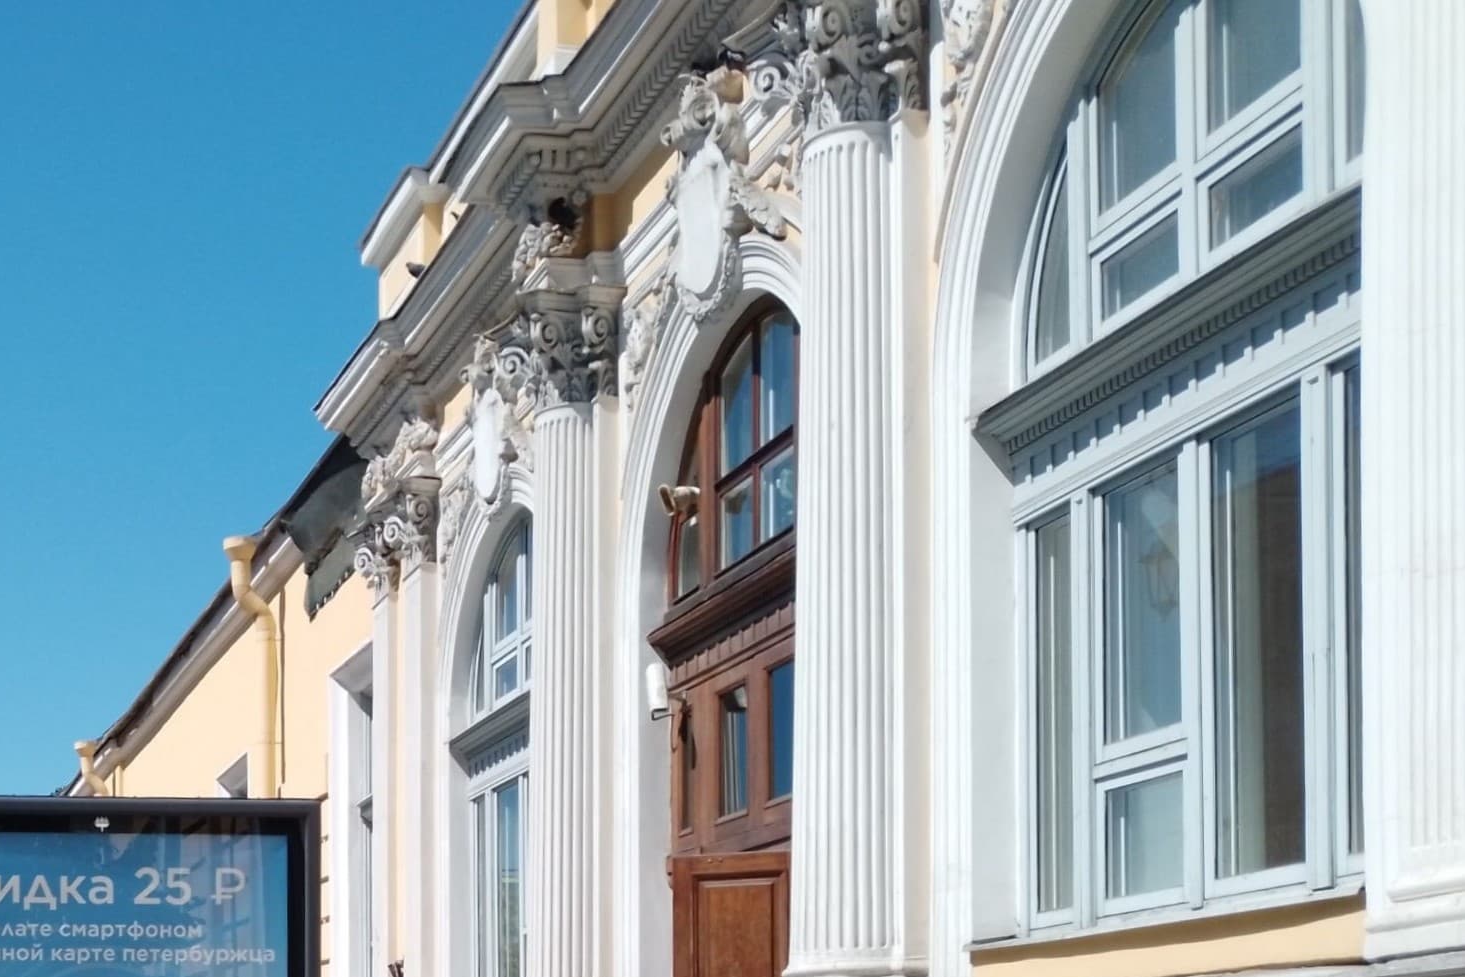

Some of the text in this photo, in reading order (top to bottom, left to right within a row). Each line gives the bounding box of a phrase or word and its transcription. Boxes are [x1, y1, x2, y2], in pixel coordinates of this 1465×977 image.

[134, 866, 192, 906] 25
[58, 920, 203, 941] смартфоном
[50, 946, 115, 965] карте
[123, 944, 276, 966] петербуржца
